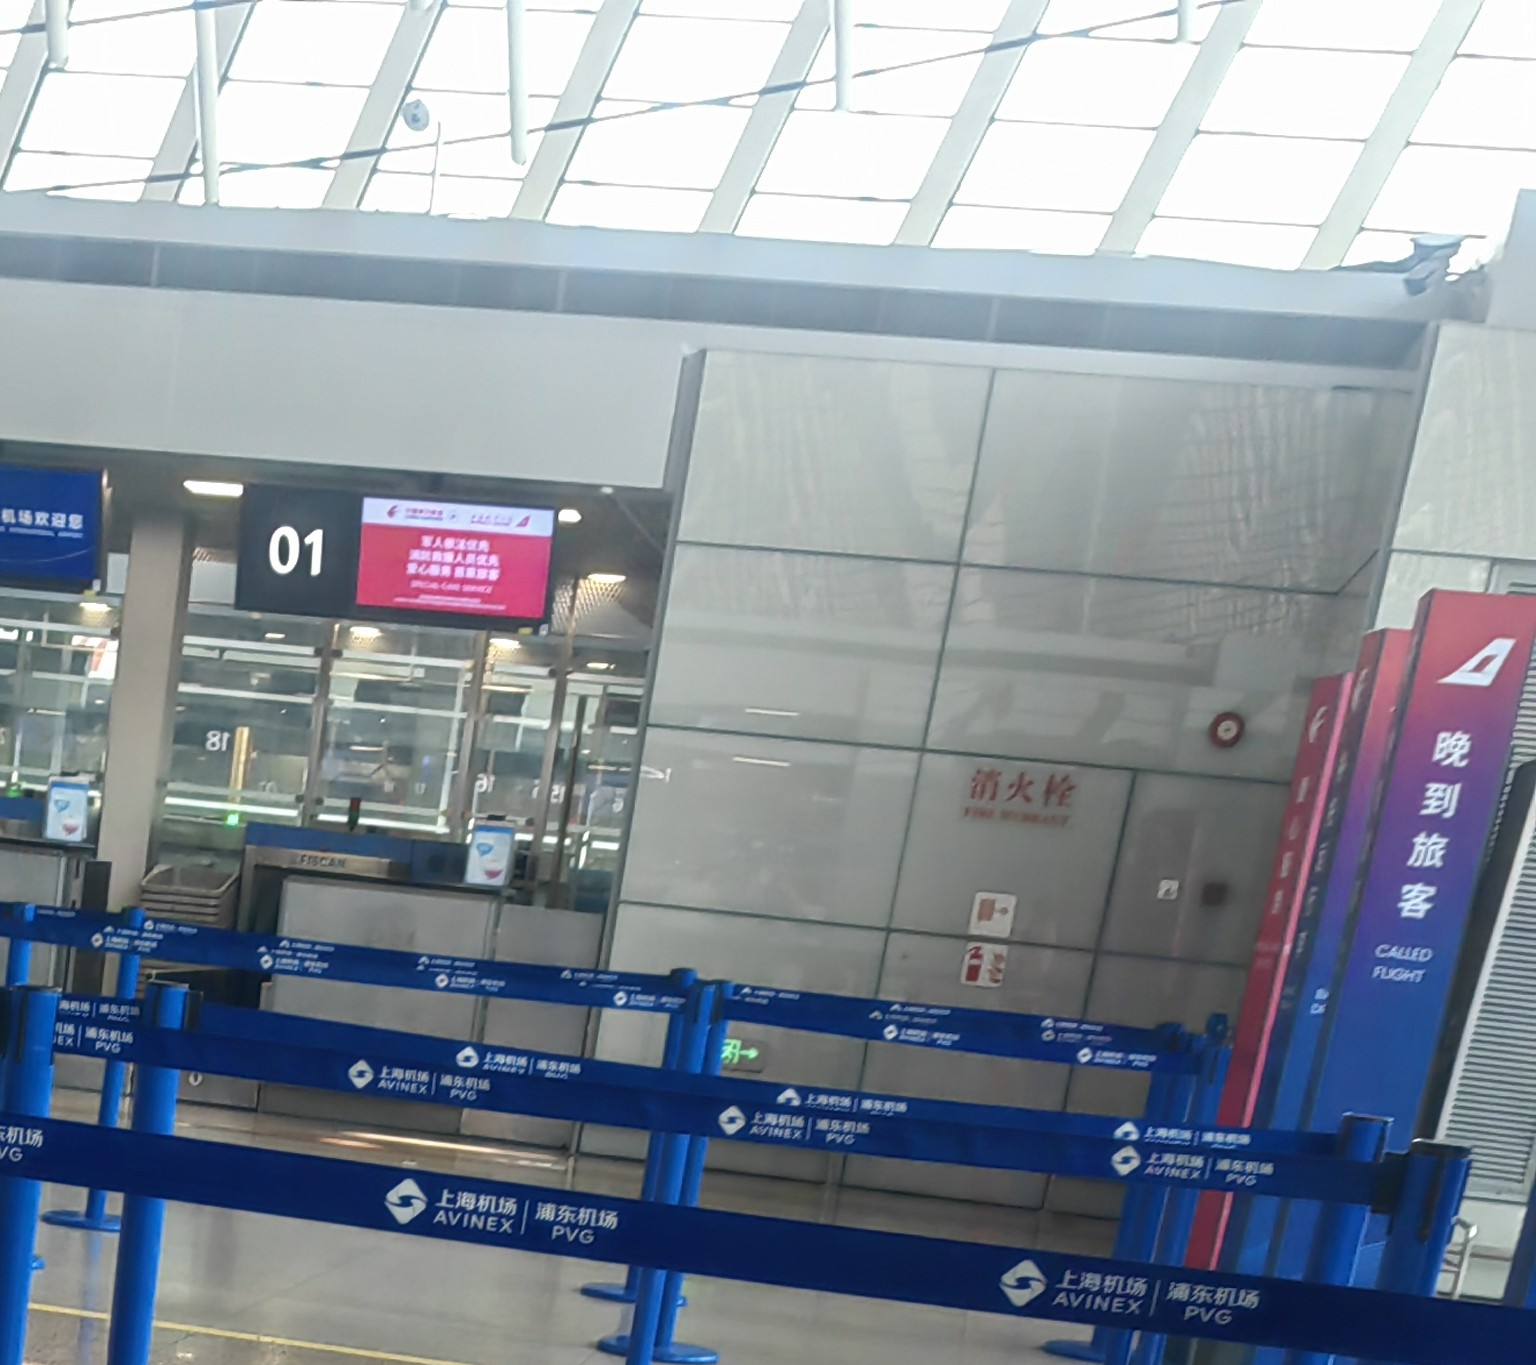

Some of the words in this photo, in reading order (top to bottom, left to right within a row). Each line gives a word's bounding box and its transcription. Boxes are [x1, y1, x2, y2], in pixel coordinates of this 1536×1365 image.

[268, 525, 325, 577] 01
[970, 769, 1076, 806] 消火栓
[1397, 730, 1472, 920] 晚到旅客
[1374, 944, 1434, 963] CALLED
[1371, 965, 1426, 983] FLIGHT
[85, 1026, 134, 1044] 浦东机场
[95, 1040, 121, 1054] PVG
[378, 1078, 429, 1095] AVINEX
[449, 1088, 478, 1101] PVG
[380, 1065, 430, 1083] 上海机场
[440, 1074, 491, 1091] 浦东机场
[749, 1125, 804, 1140] AVINEX
[825, 1132, 856, 1146] PVG
[751, 1111, 806, 1129] 上海机场
[816, 1118, 871, 1136] 浦东机场
[1144, 1164, 1203, 1180] AVINEX
[1225, 1172, 1258, 1187] PVG
[1146, 1152, 1205, 1169] 上海机场
[1215, 1158, 1275, 1176] 浦东机场
[434, 1188, 518, 1217] 上海机场
[534, 1201, 619, 1230] 浦东机场
[432, 1209, 514, 1234] AVINEX
[551, 1224, 596, 1245] PVG
[1054, 1268, 1149, 1298] 上海机场
[1165, 1280, 1261, 1309] 浦东机场
[1051, 1290, 1145, 1315] AVINEX
[1182, 1305, 1234, 1326] PVG
